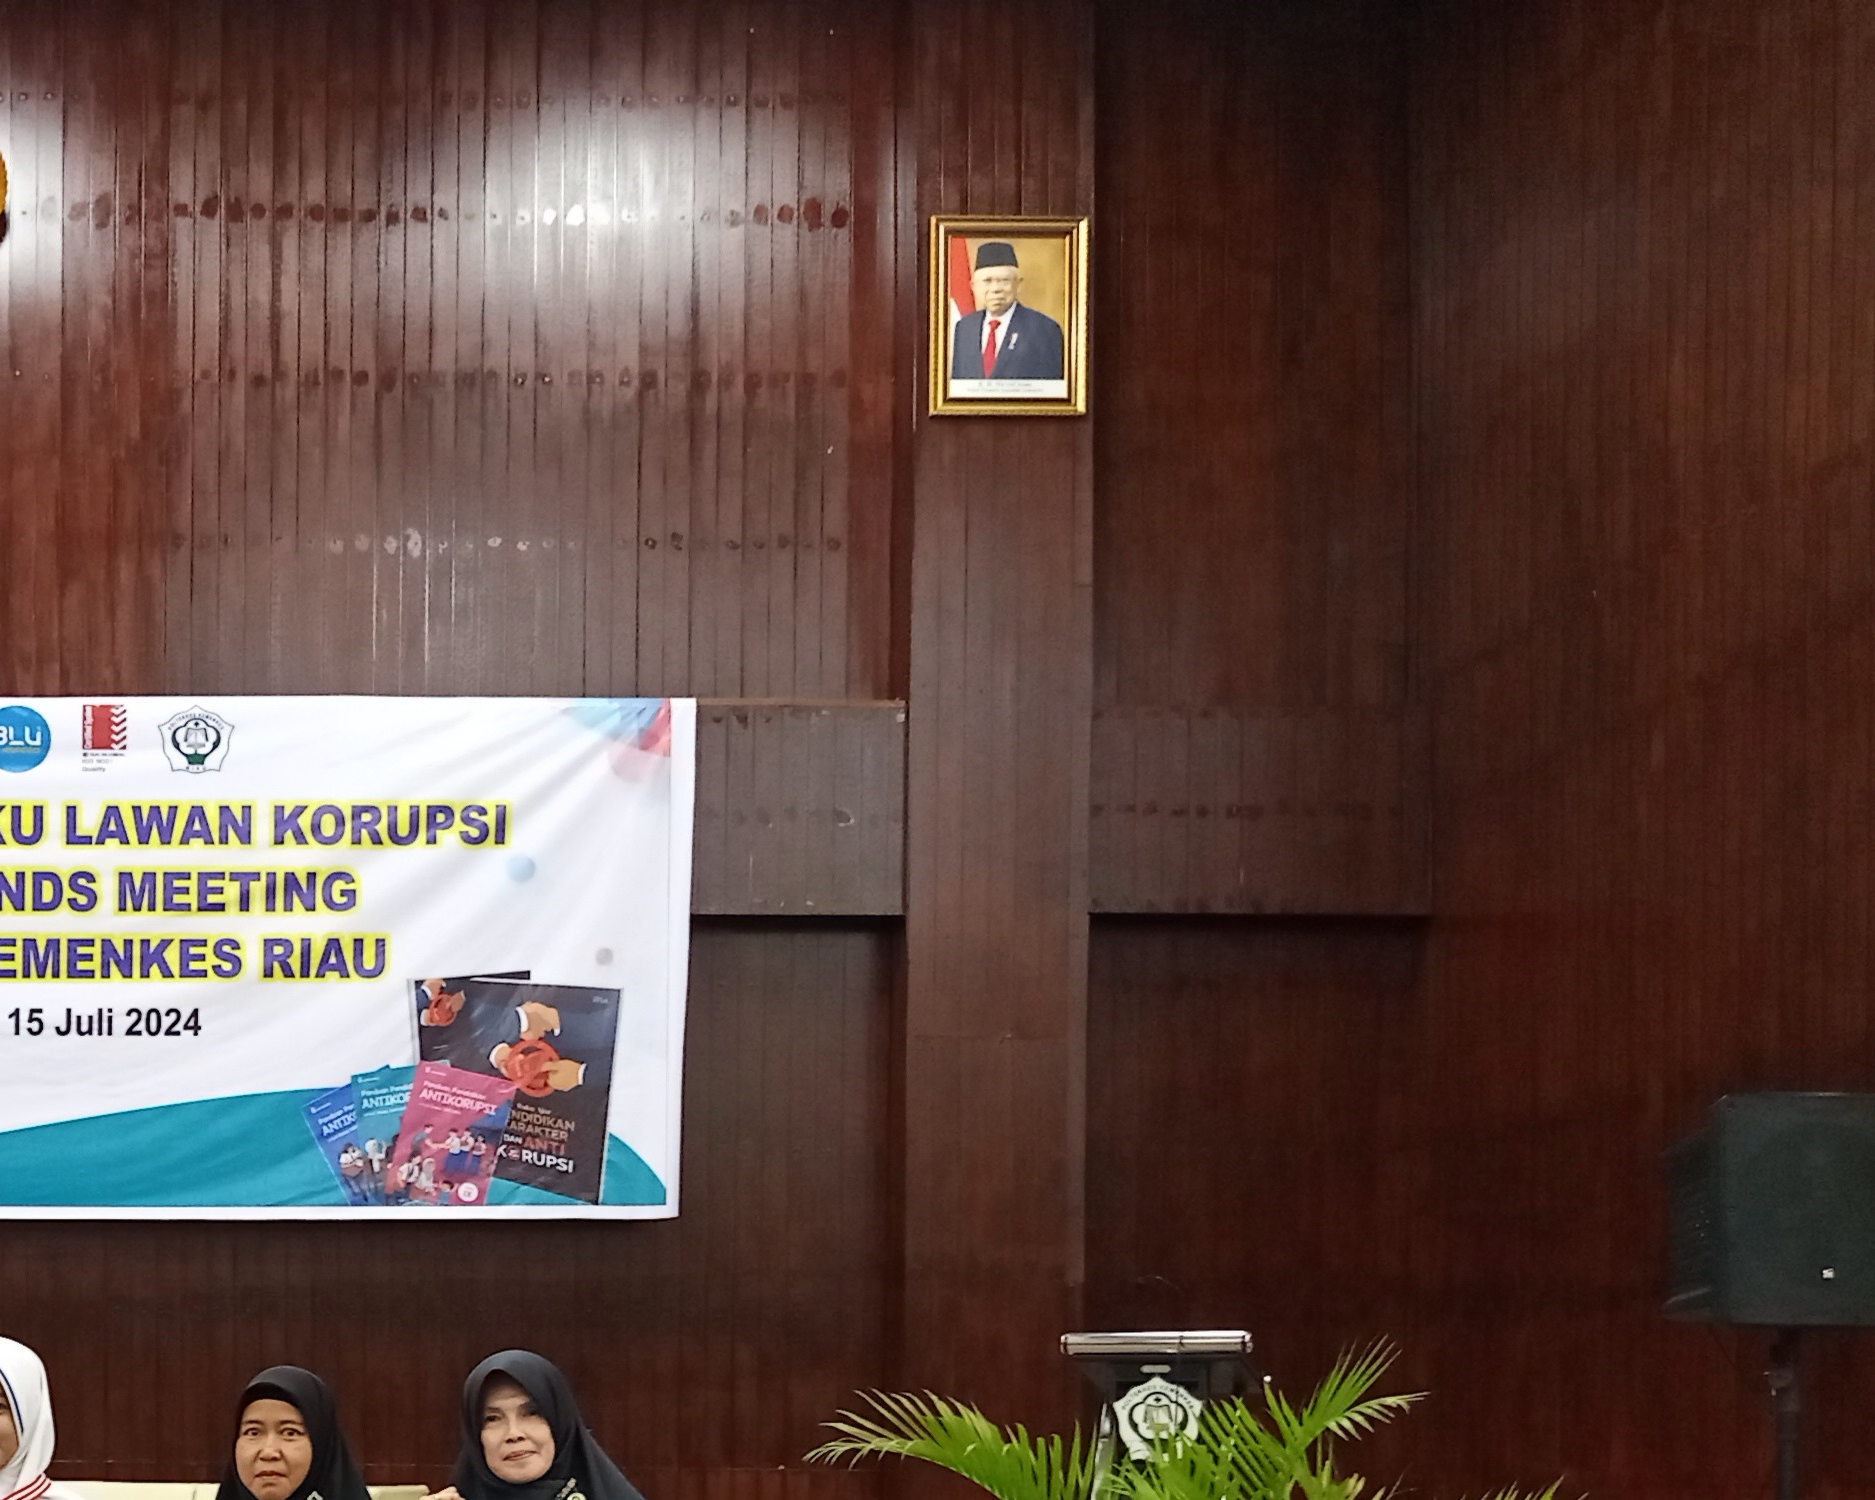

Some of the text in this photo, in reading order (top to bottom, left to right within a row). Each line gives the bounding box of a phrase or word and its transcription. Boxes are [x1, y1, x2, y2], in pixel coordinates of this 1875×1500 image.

[65, 804, 253, 846] LAWAN
[273, 804, 508, 846] KORUPSI
[117, 870, 359, 912] MEETING
[262, 937, 388, 979] RIAU
[9, 1008, 45, 1037] 15
[54, 1007, 114, 1038] Juli
[124, 1008, 203, 1037] 2024
[418, 1087, 499, 1116] ANTIKORUPSI
